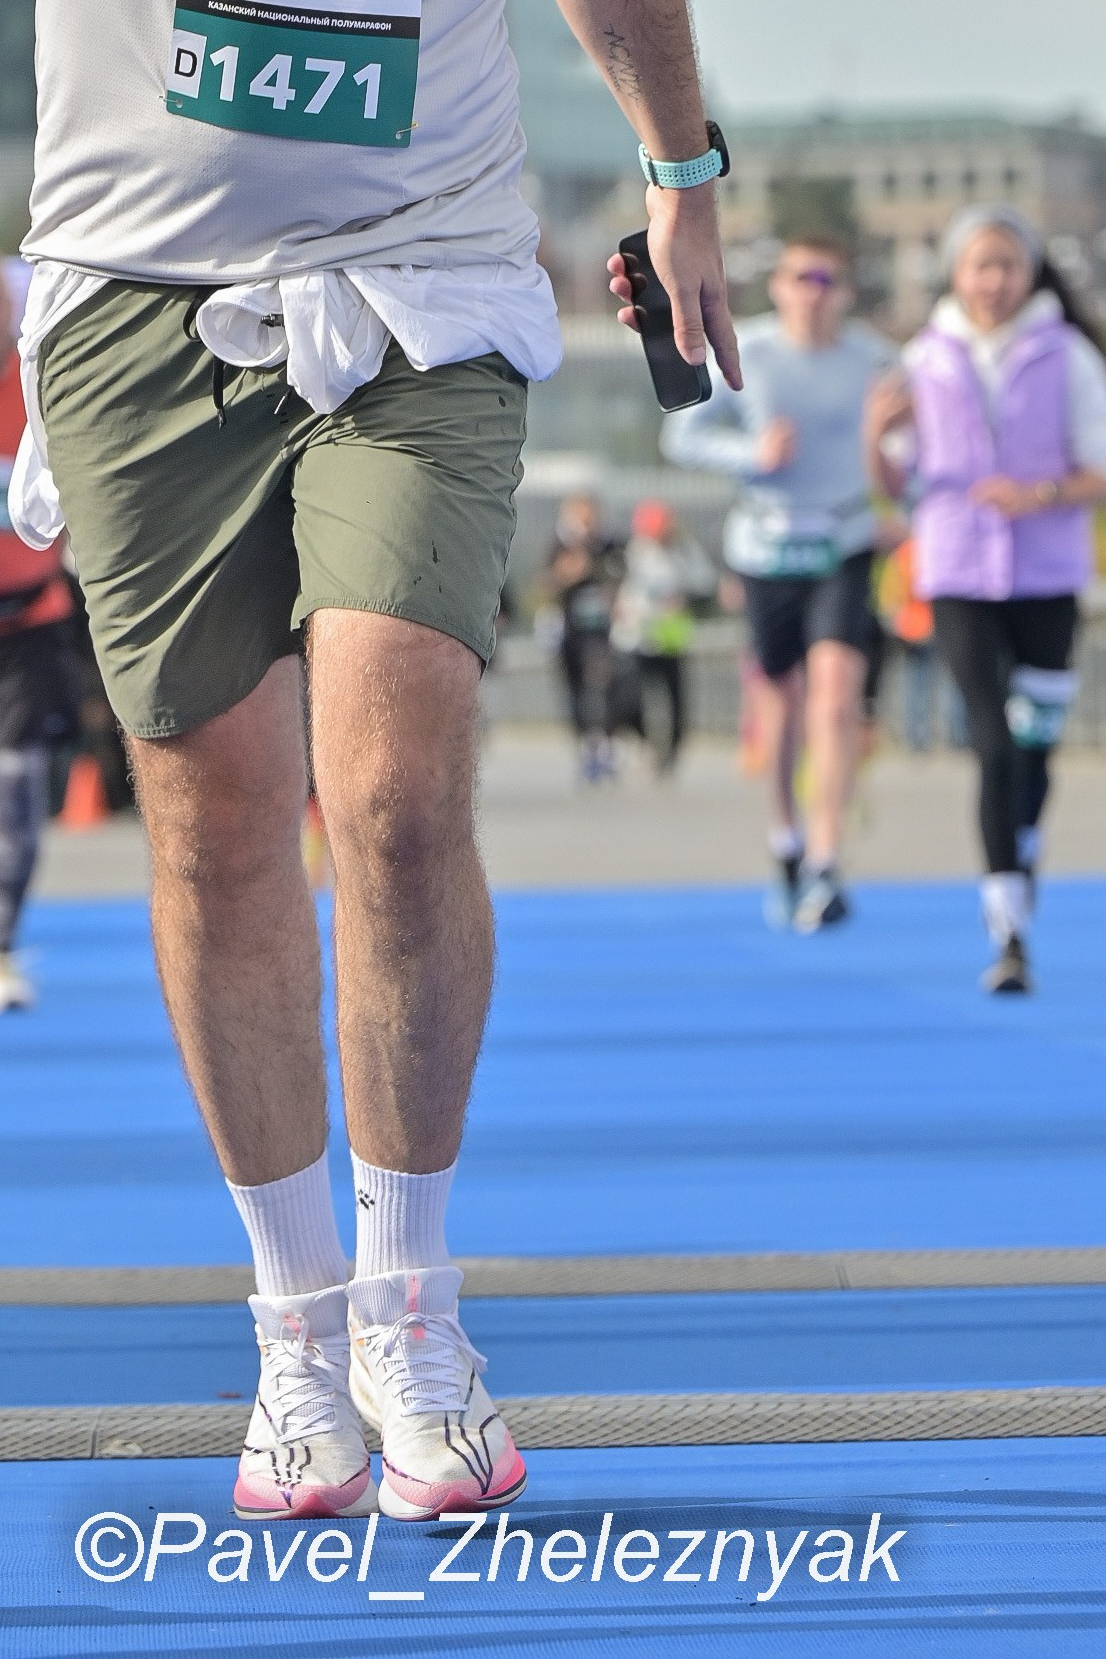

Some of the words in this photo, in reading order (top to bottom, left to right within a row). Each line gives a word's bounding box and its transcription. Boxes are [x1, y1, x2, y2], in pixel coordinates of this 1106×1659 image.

[207, 0, 257, 18] КАЗАНСКИЙ
[257, 8, 330, 28] НАЦИОНАЛЬНЫЙ
[330, 18, 392, 31] ПОЛУМАРАФОН
[173, 47, 198, 79] D
[209, 45, 382, 120] 1471
